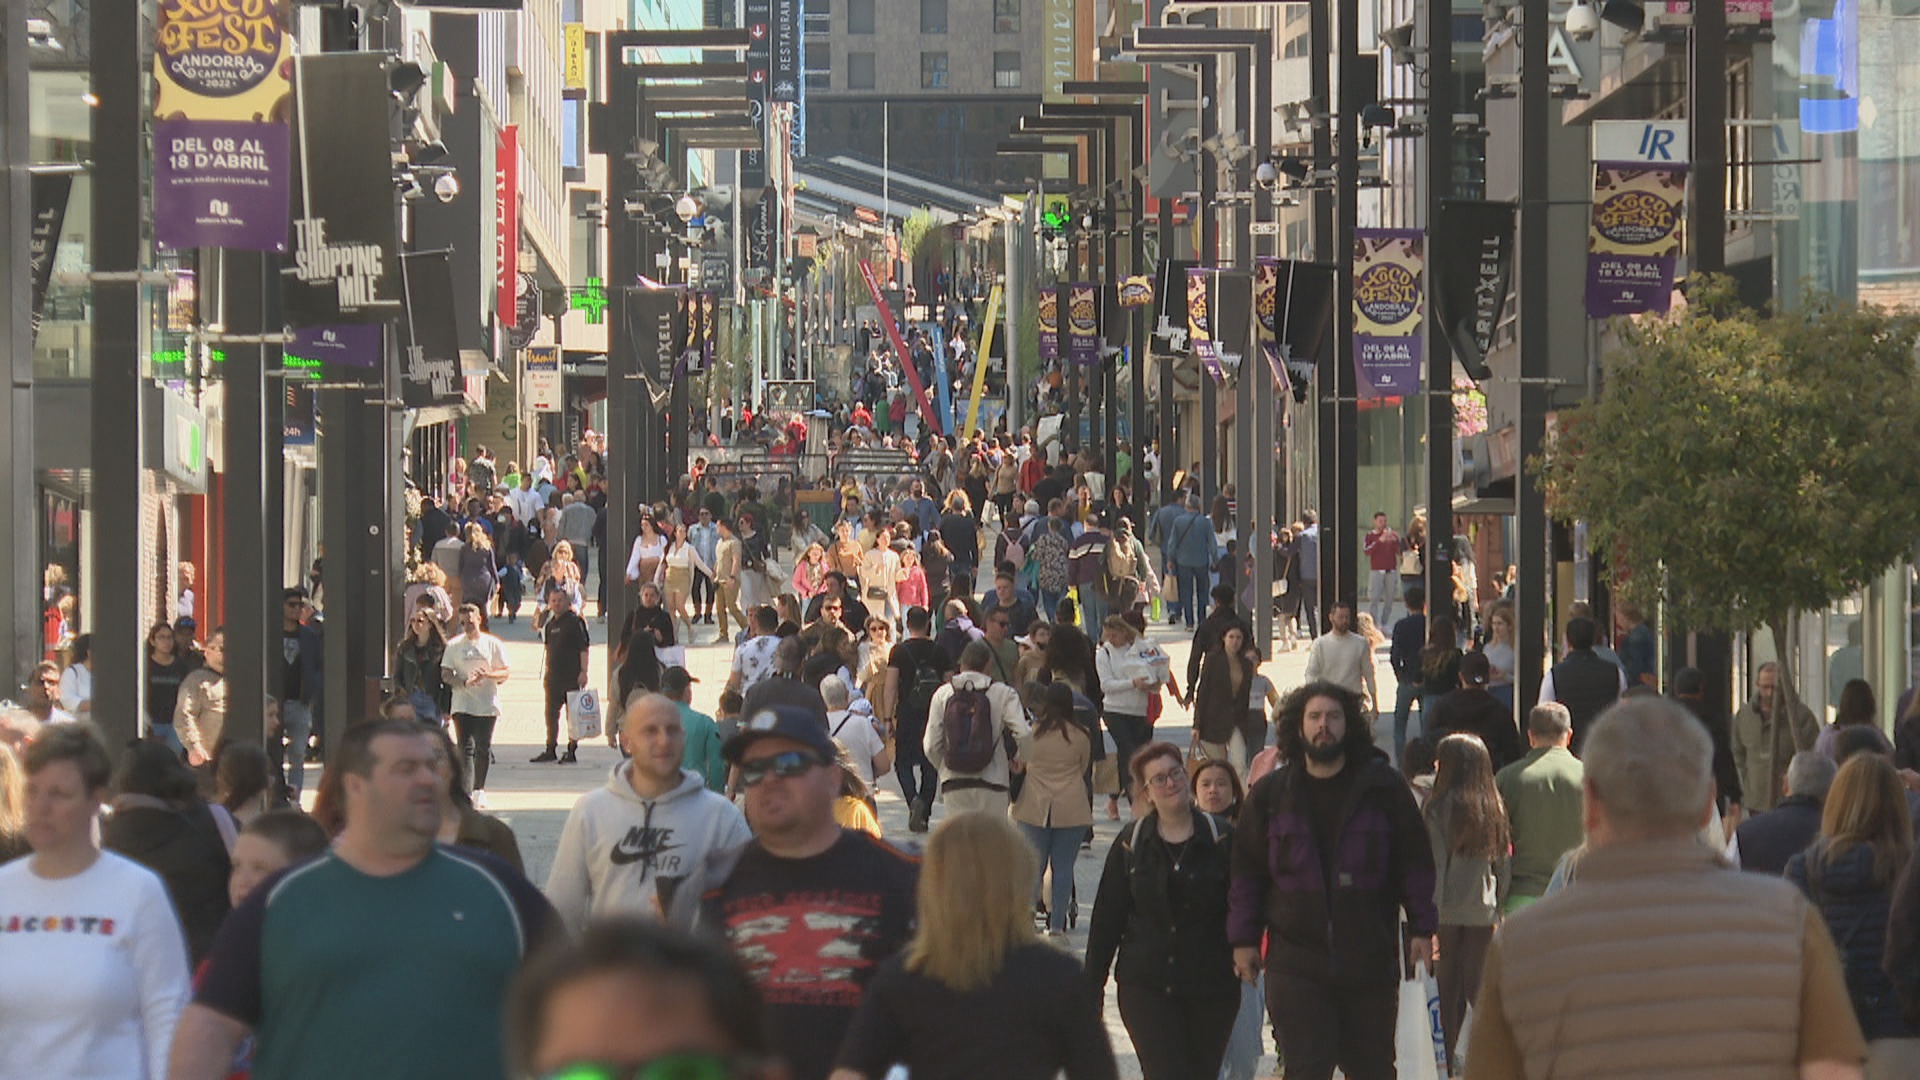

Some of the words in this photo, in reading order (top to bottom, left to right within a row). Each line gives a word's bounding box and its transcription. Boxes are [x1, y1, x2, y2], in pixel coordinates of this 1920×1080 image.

[163, 13, 275, 55] FEST
[181, 54, 255, 68] ANDORRA
[198, 69, 238, 79] CAPITAL
[206, 80, 231, 88] 2022
[172, 137, 206, 153] DEL
[212, 137, 235, 152] 08
[240, 138, 264, 155] AL
[1639, 124, 1674, 160] IR
[169, 154, 189, 169] 18
[195, 153, 269, 171] D'ABRIL
[1606, 194, 1667, 212] XOCO
[1601, 209, 1673, 228] FEST
[293, 217, 328, 249] THE
[295, 245, 383, 281] SHOPPING
[1364, 266, 1411, 285] XOCO
[1615, 270, 1661, 279] D'ABRIL
[338, 275, 385, 307] MILE
[1360, 283, 1416, 304] FEST
[1363, 344, 1380, 352] DEL
[1397, 344, 1409, 352] AL
[1375, 352, 1411, 360] D'ABRIL
[622, 827, 675, 849] NIKE
[0, 915, 115, 936] ACOSTE
